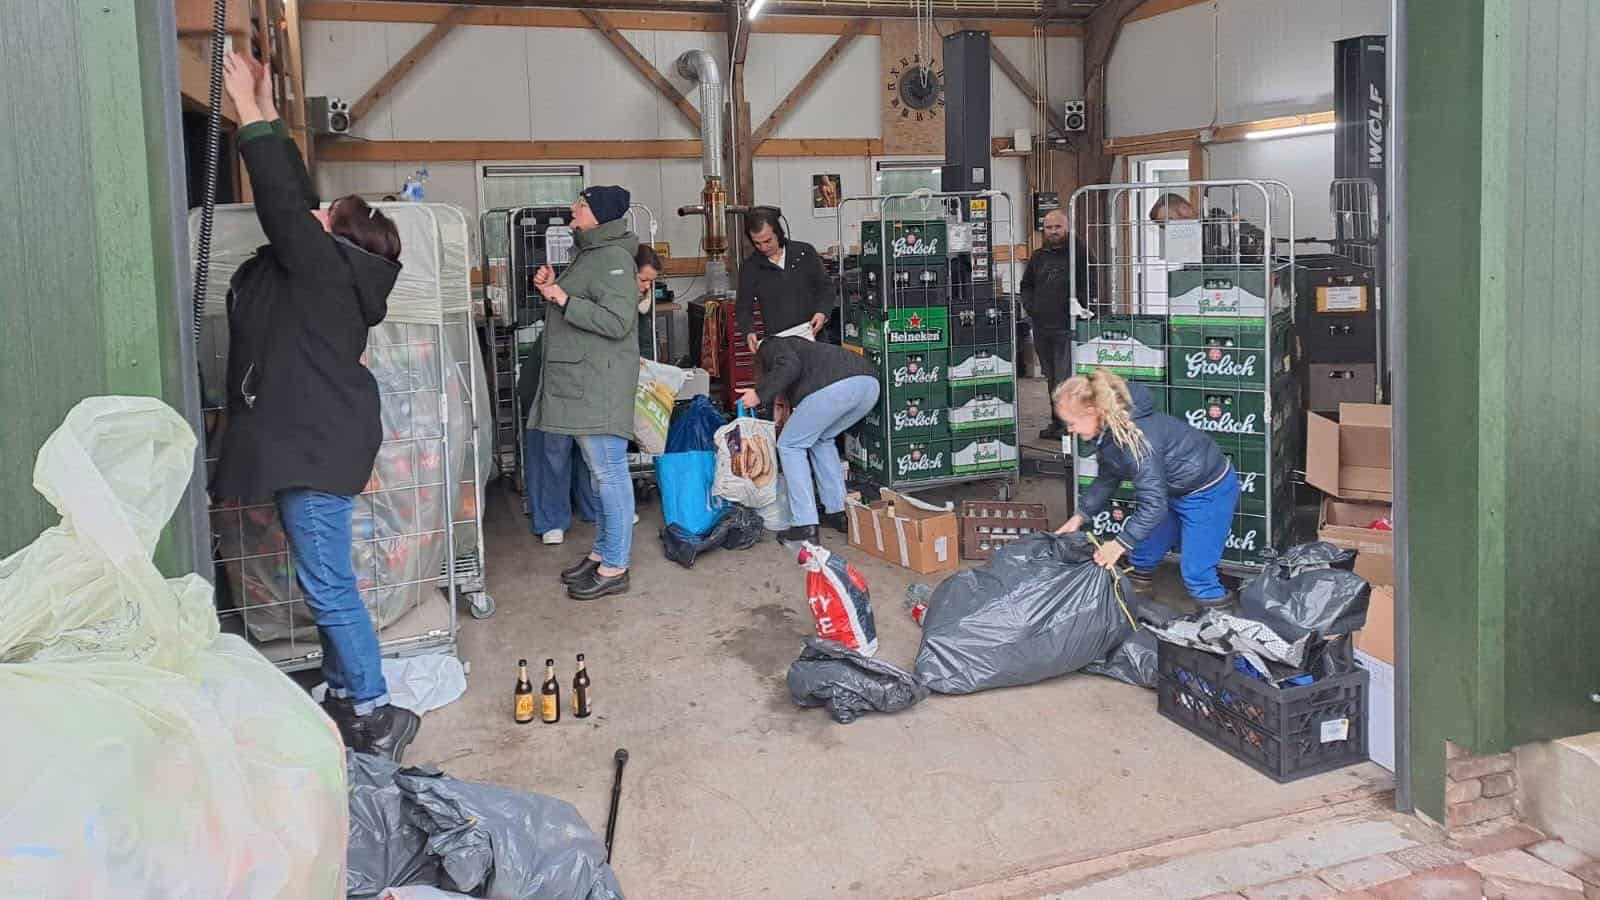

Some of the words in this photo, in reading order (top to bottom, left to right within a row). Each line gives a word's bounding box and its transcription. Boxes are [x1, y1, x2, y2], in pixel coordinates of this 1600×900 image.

[1368, 83, 1383, 165] WOLF
[891, 237, 938, 258] Grolsch
[889, 331, 942, 343] Heineken
[893, 366, 939, 387] Grolsch
[1185, 352, 1257, 378] Grolsch
[893, 408, 940, 431] Grolsch
[1185, 409, 1257, 433] Grolsch
[897, 452, 943, 475] Grolsch
